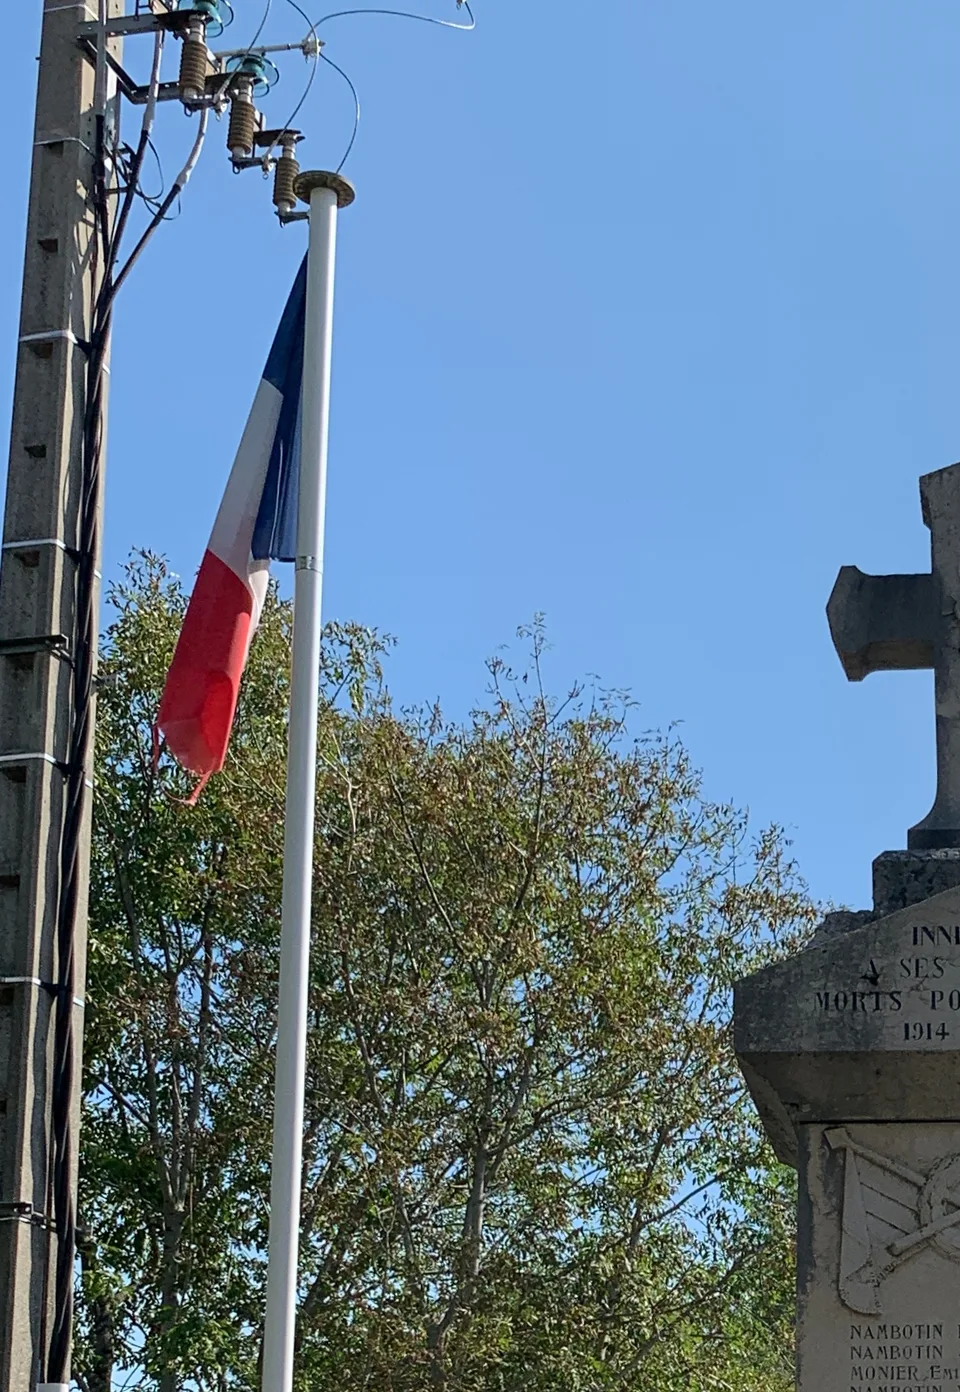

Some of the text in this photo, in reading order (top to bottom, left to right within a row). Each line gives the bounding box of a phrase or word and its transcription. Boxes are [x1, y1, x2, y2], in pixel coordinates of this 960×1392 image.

[900, 957, 945, 978] SES
[814, 990, 902, 1012] MORTS
[903, 1021, 950, 1042] 1914
[850, 1324, 944, 1340] NAMBOTIN
[850, 1345, 943, 1360] NAMBOTIN
[851, 1365, 919, 1381] MONIER
